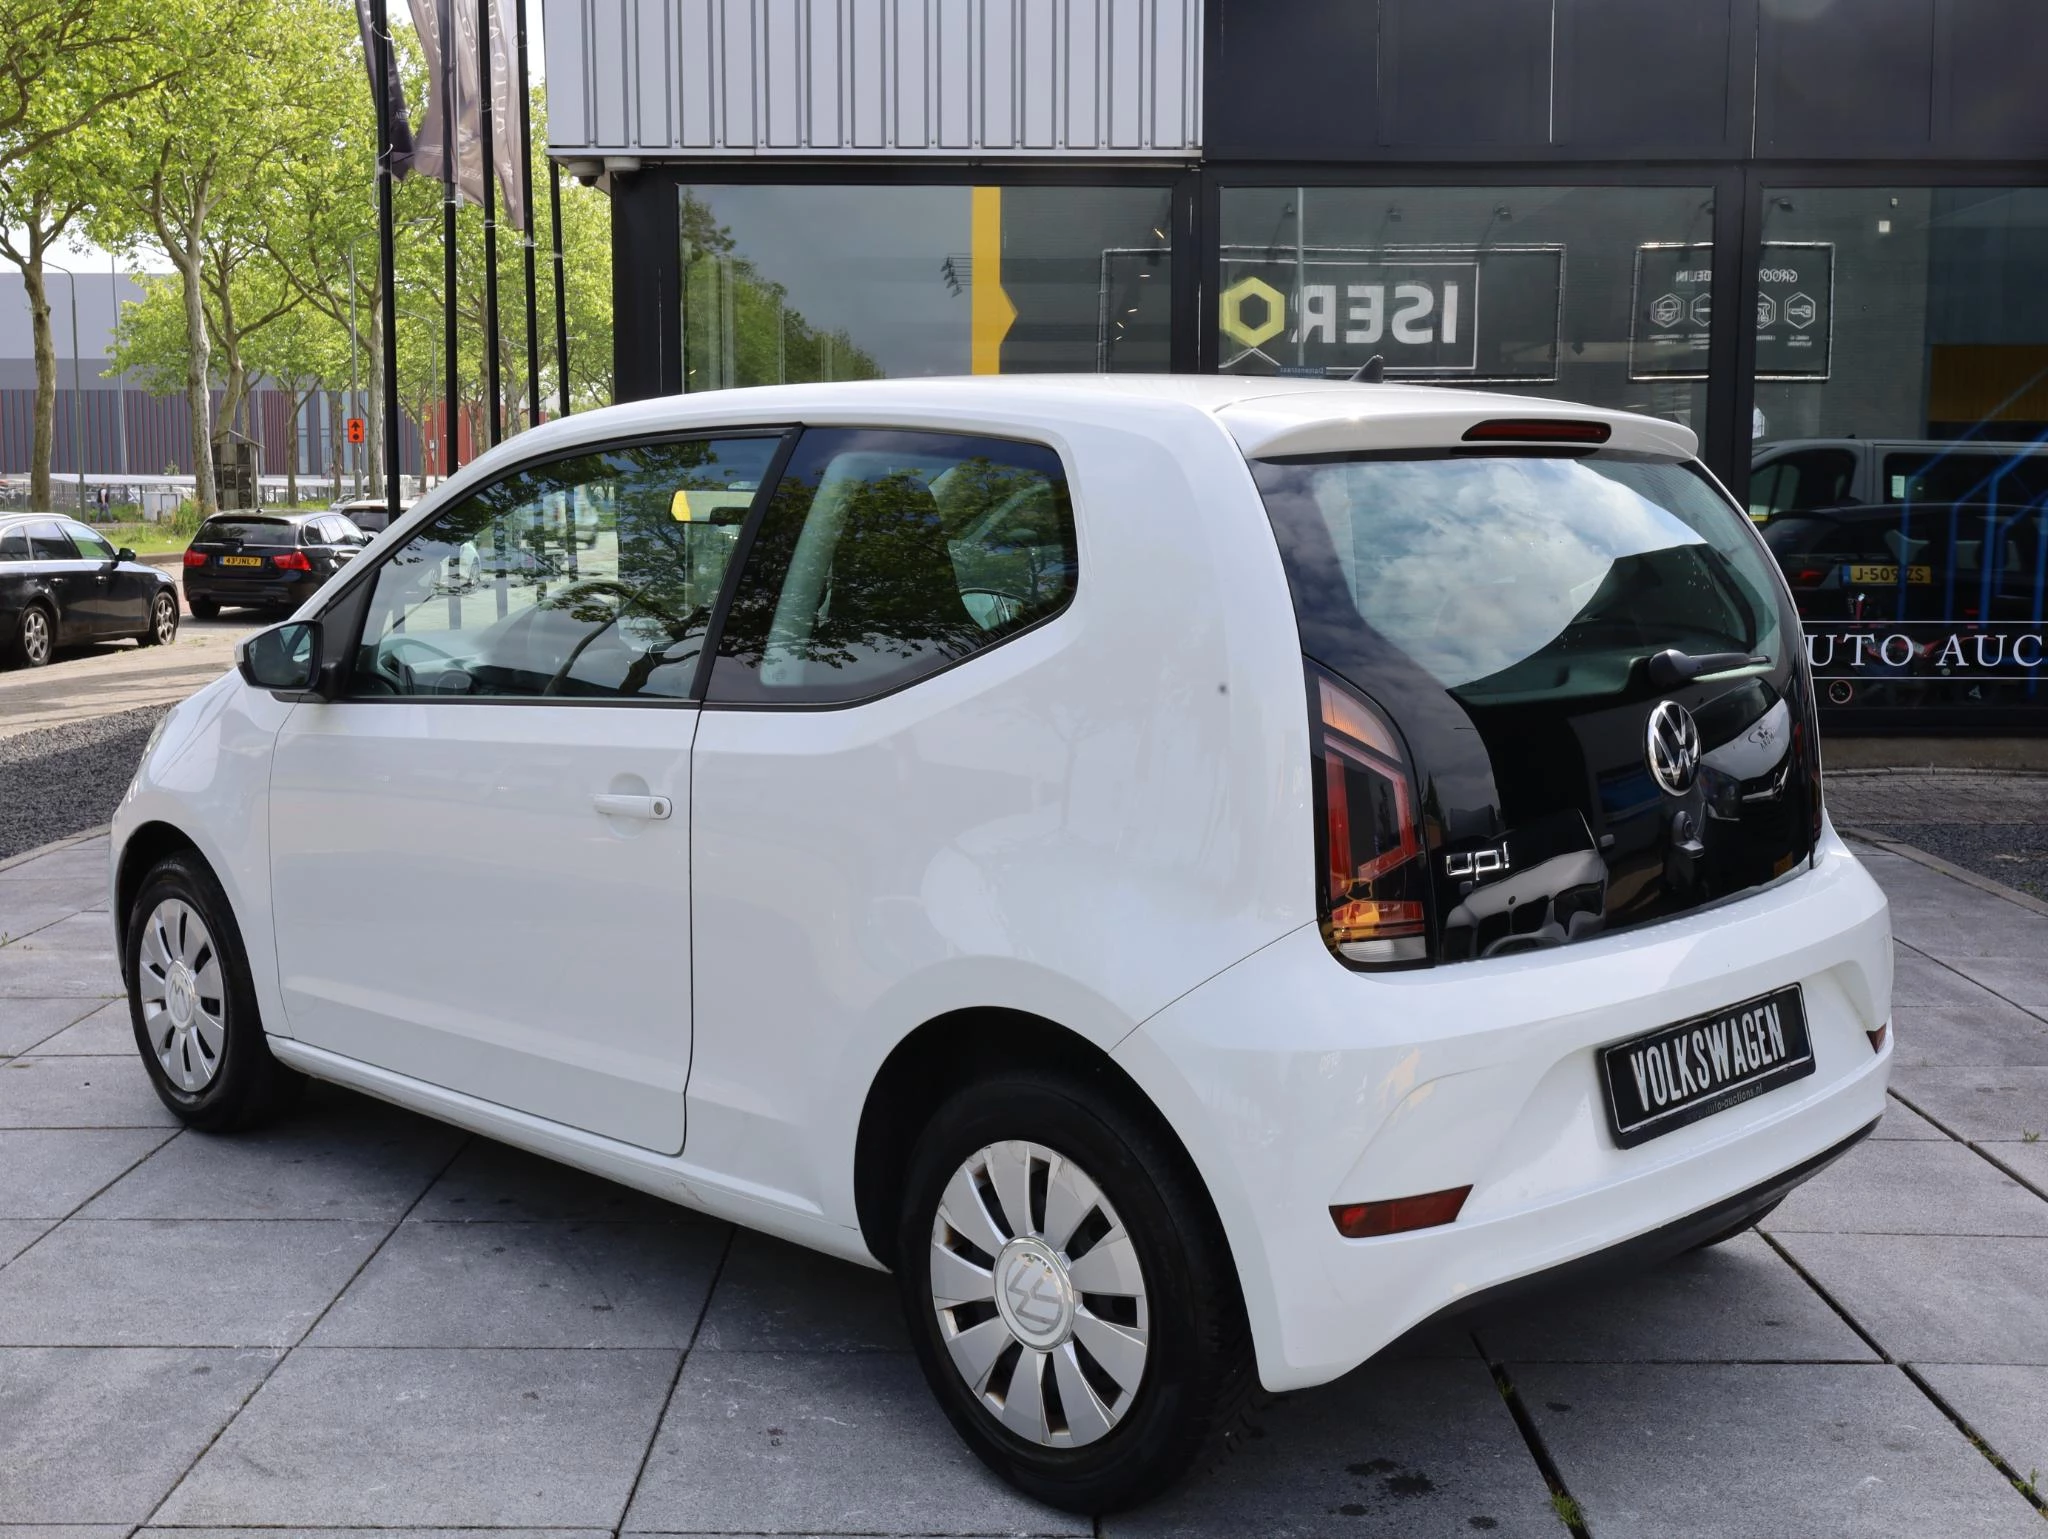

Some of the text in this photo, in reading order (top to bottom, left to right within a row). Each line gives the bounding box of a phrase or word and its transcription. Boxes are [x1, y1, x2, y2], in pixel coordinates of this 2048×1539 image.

[1935, 633, 2043, 667] AUC
[1446, 841, 1510, 880] up!
[1629, 1002, 1786, 1112] VOLKSWAGEN
